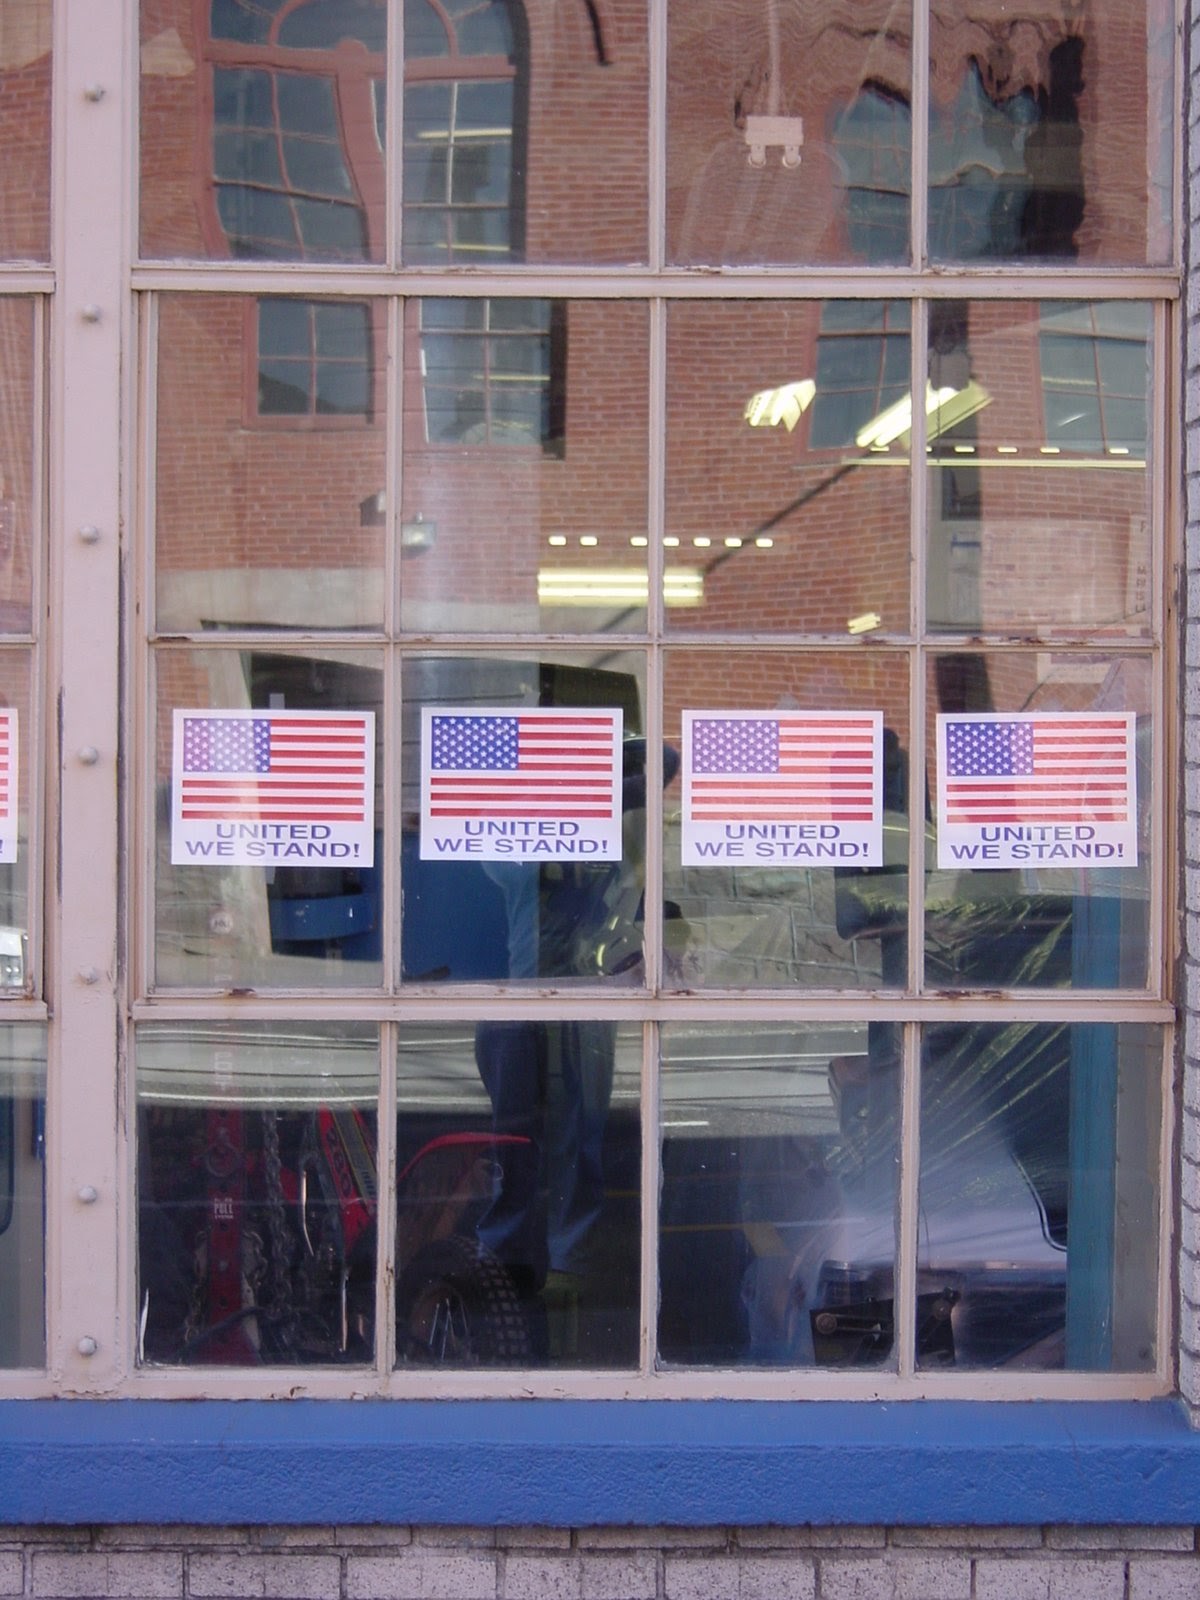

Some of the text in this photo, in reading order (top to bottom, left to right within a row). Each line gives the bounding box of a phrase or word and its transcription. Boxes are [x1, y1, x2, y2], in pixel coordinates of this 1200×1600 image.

[217, 824, 331, 839] UNITED
[465, 821, 579, 836] UNITED
[726, 825, 840, 839] UNITED
[981, 826, 1095, 842] UNITED
[185, 841, 359, 857] WE STAND!
[434, 838, 607, 853] WE STAND!
[695, 842, 868, 857] WE STAND!
[951, 843, 1123, 859] WE STAND!
